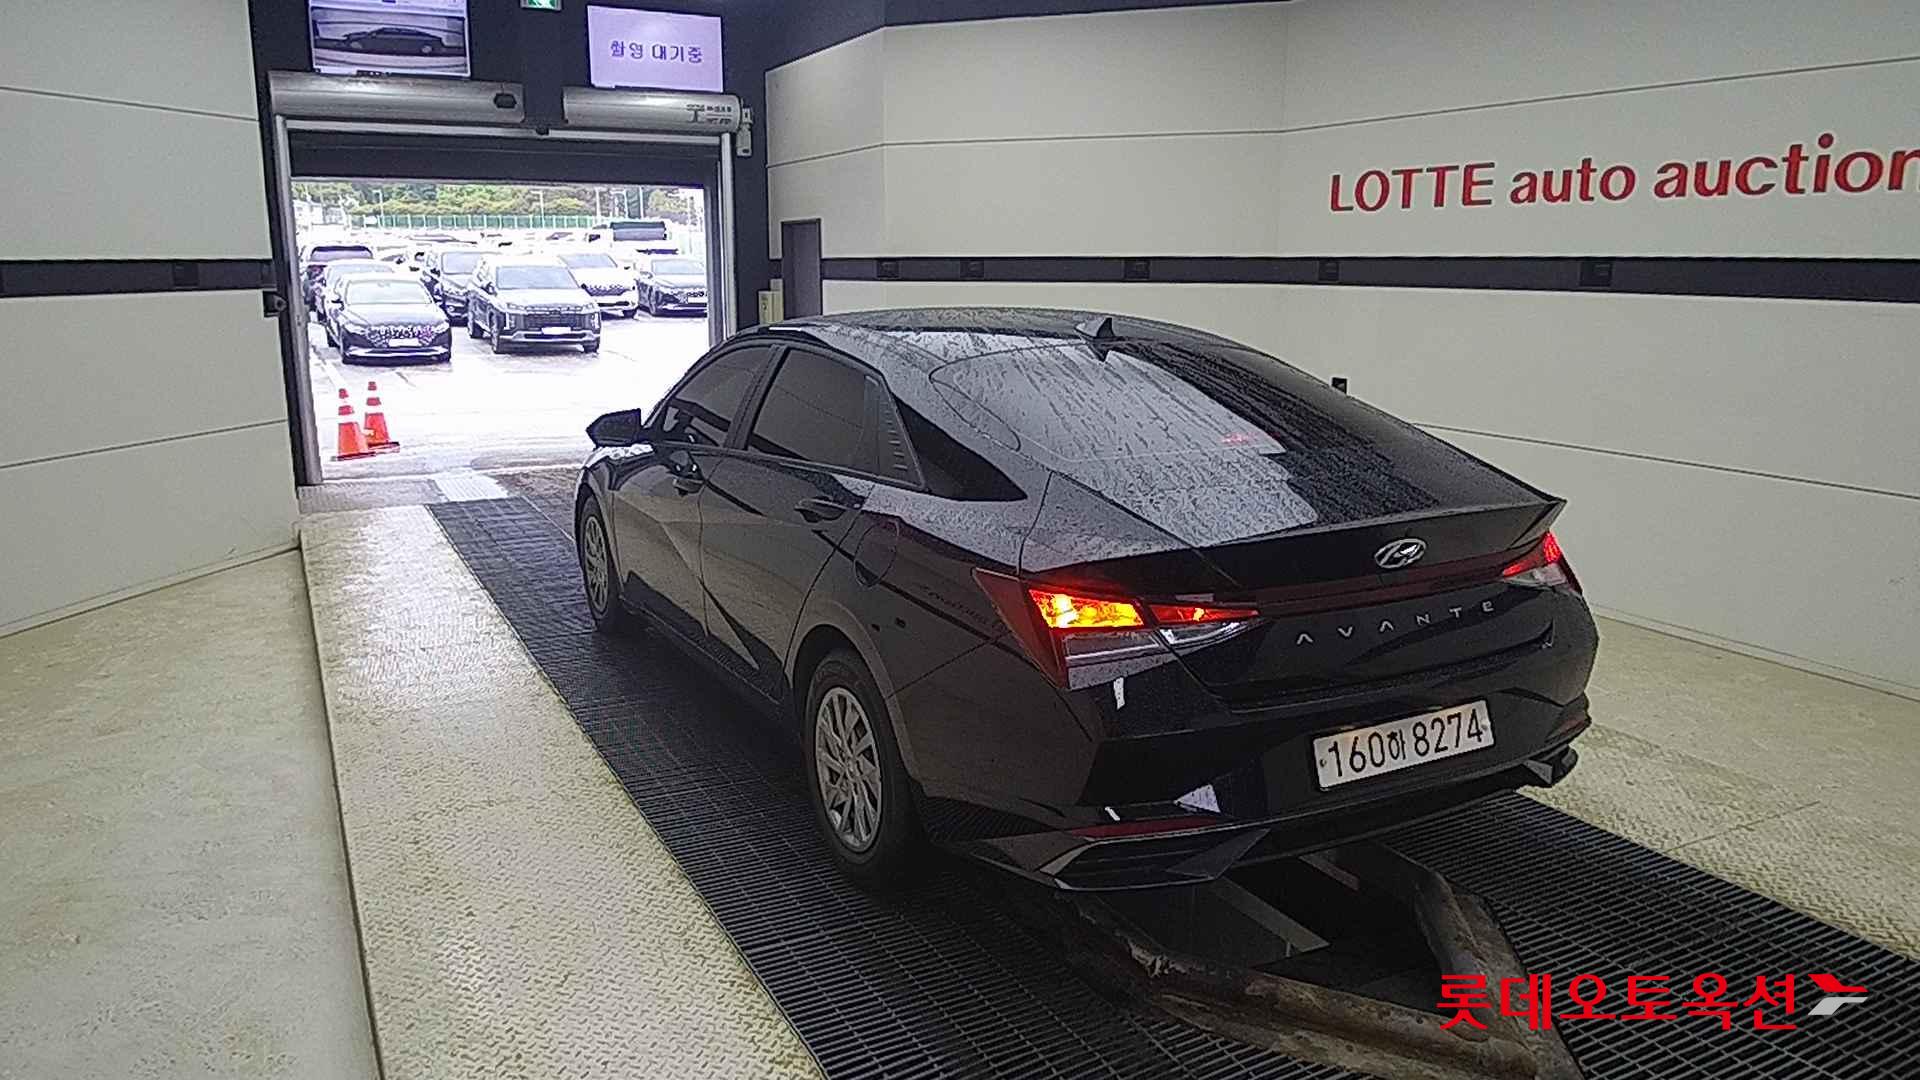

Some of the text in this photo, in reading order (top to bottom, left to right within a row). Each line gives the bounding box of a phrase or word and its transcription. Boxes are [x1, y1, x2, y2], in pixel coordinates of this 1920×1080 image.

[651, 43, 703, 63] 대기중
[1330, 162, 1496, 211] LOTTE
[1510, 158, 1636, 203] auto
[1297, 600, 1494, 646] AVANTE
